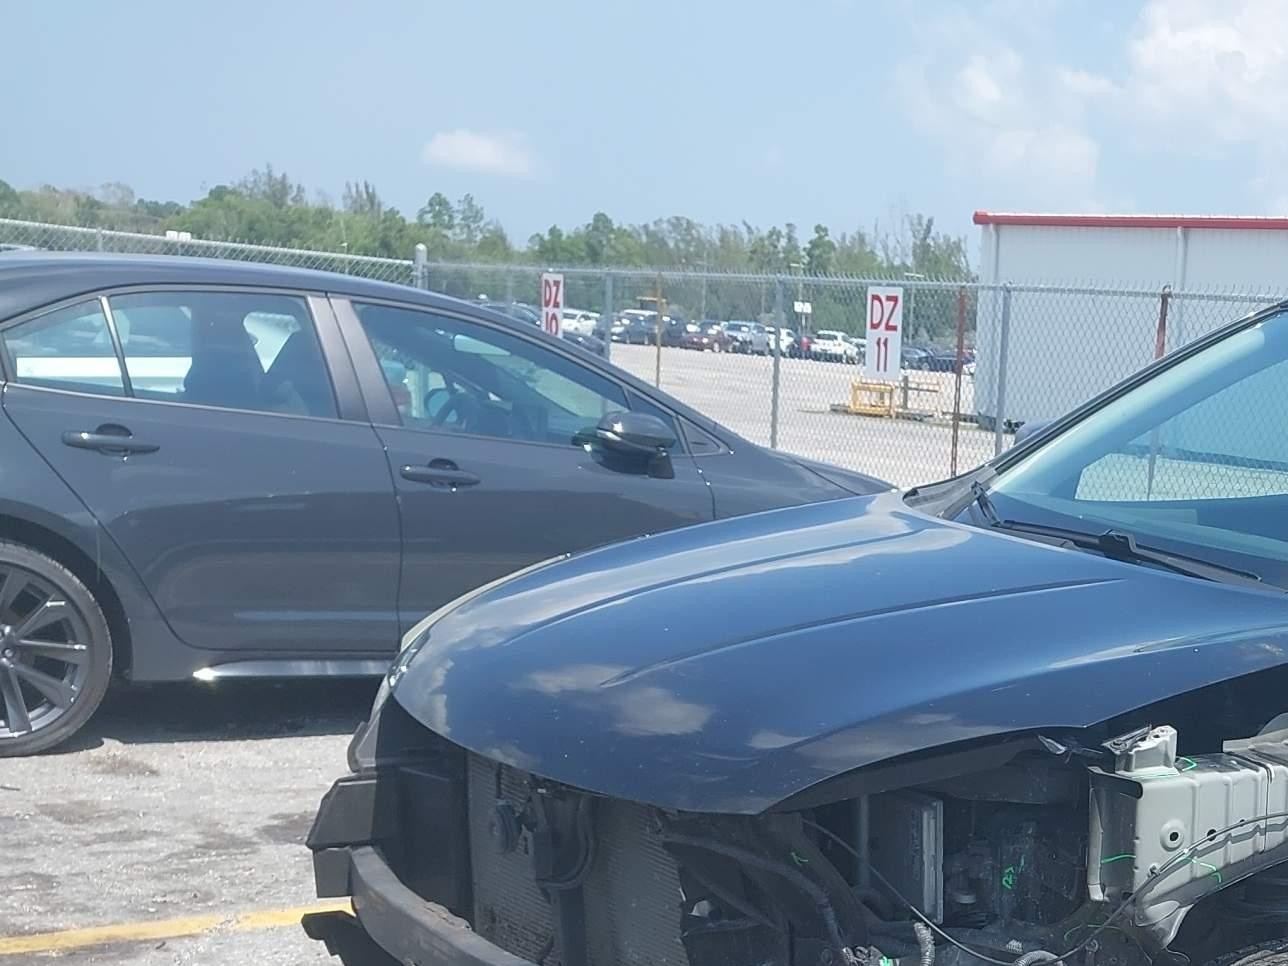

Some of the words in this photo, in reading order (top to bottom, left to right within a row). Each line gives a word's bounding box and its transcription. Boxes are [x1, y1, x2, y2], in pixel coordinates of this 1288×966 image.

[543, 279, 561, 308] DZ
[869, 294, 899, 331] DZ
[876, 337, 889, 373] 11
